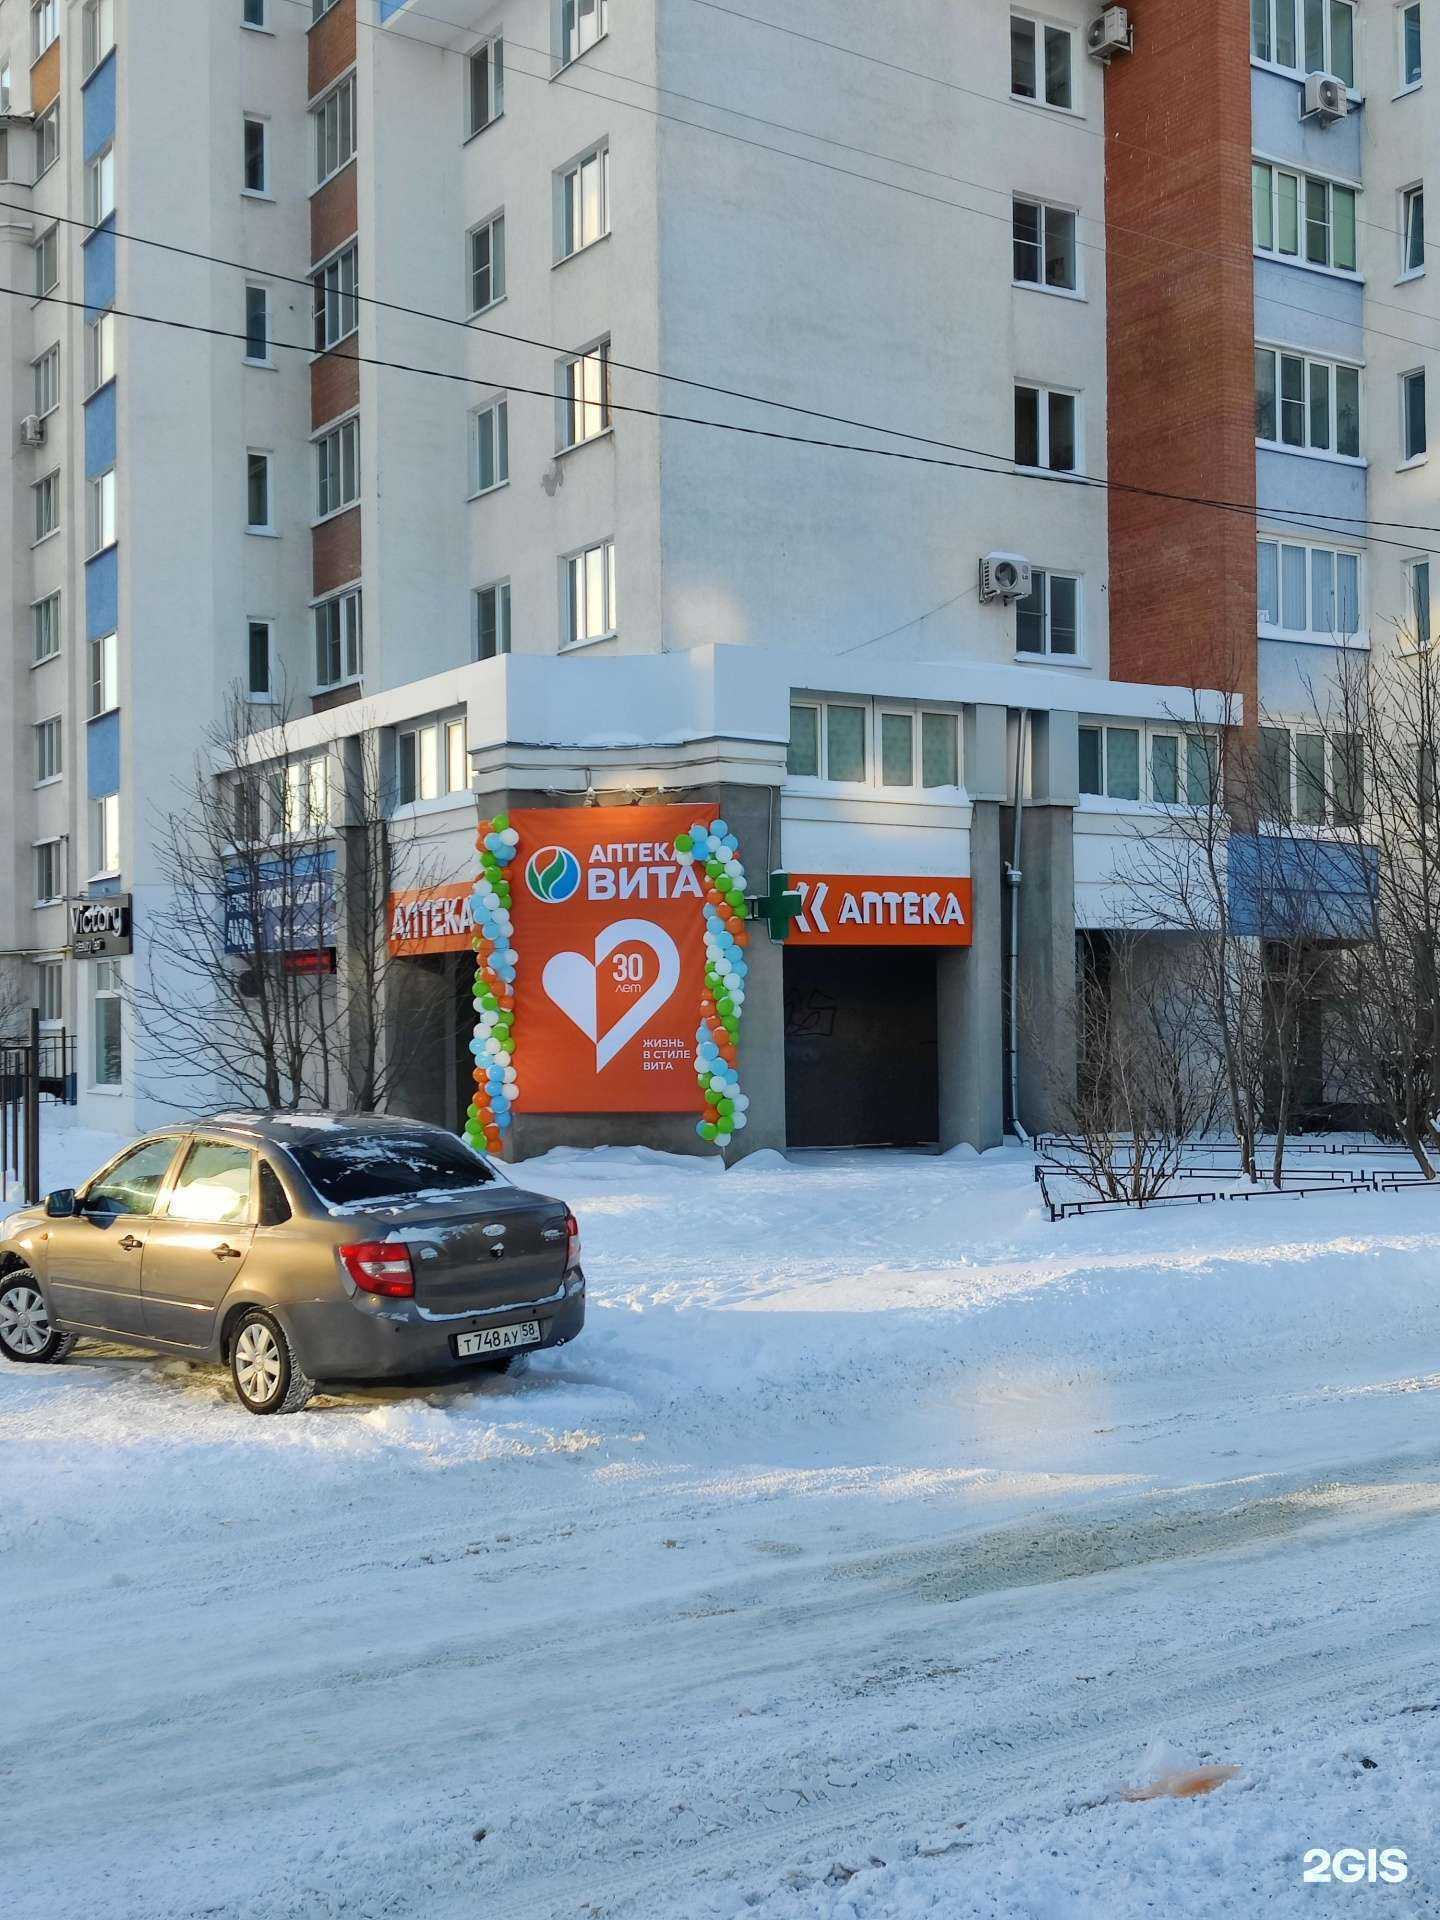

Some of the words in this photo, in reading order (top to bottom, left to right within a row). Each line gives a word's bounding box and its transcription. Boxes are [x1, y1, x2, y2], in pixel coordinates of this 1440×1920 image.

[588, 842, 678, 864] АПТЕК
[587, 866, 704, 901] ВИТА
[390, 895, 475, 940] АПТЕКА
[838, 891, 965, 925] АПТЕКА
[70, 904, 121, 938] Victory
[612, 953, 643, 981] 30
[615, 983, 642, 993] лет
[643, 1039, 684, 1048] ЖИЗНЬ
[643, 1050, 651, 1059] В
[653, 1050, 691, 1059] СТИЛЕ
[643, 1061, 674, 1071] ВИТА
[521, 1323, 535, 1337] 58
